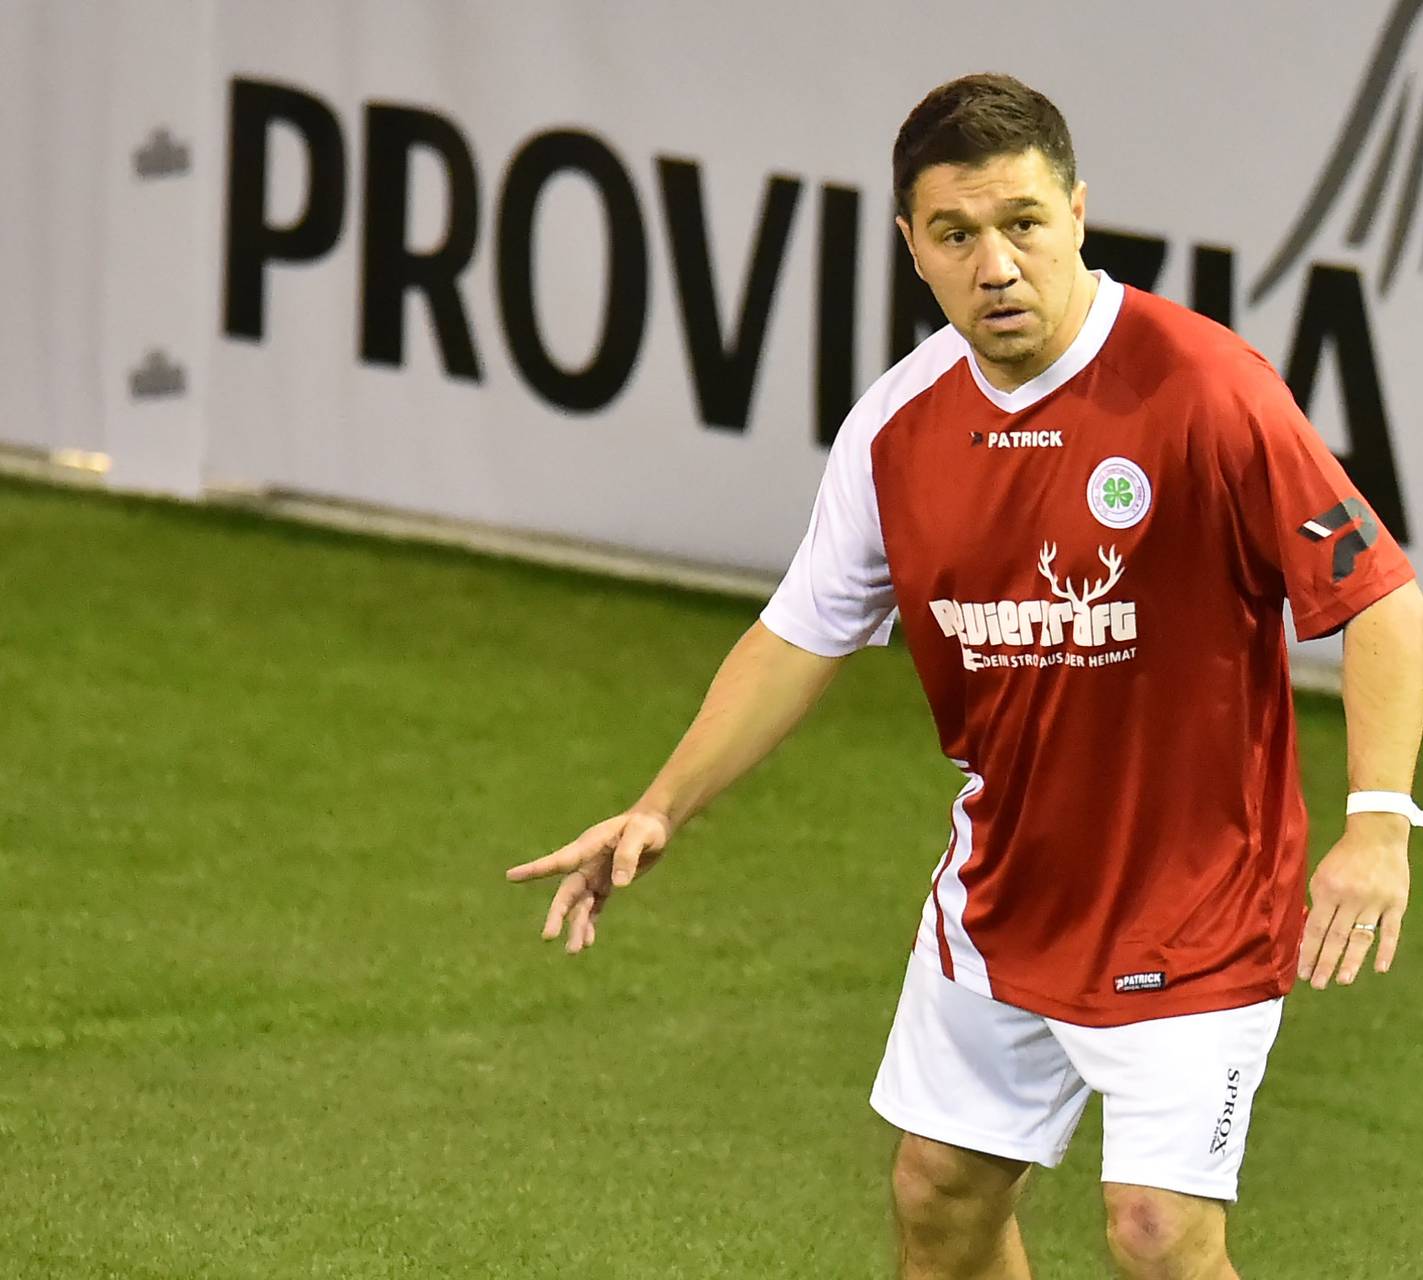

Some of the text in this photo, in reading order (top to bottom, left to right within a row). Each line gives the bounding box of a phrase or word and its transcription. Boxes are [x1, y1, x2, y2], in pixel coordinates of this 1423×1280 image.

[987, 430, 1064, 449] PATRICK
[1011, 653, 1039, 669] STRO
[1039, 652, 1065, 669] AUS
[1065, 653, 1086, 668] DER
[1088, 647, 1138, 668] HEIMAT
[1123, 973, 1161, 986] PATRICK
[1213, 1068, 1240, 1157] SPROX
